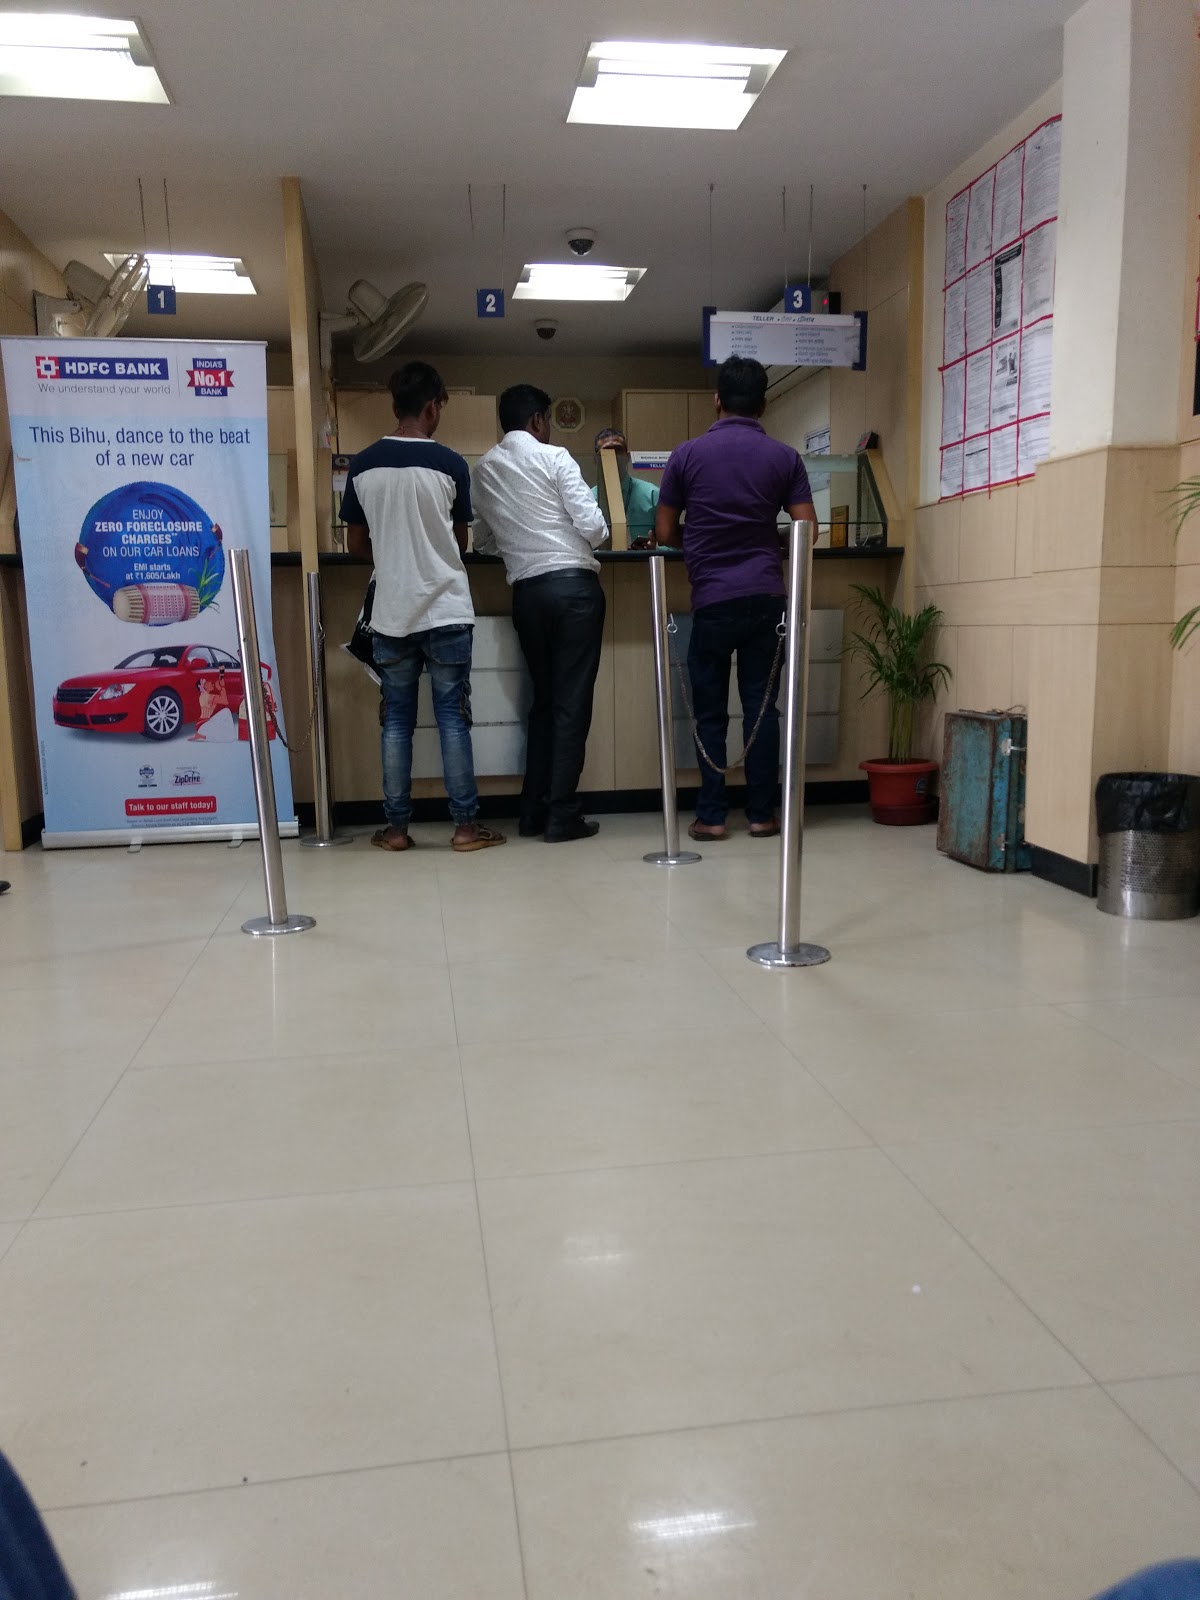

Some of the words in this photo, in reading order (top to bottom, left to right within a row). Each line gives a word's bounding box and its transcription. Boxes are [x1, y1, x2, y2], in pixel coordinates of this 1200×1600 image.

[158, 290, 165, 309] 1
[486, 294, 496, 312] 2
[793, 290, 803, 308] 3
[65, 362, 110, 375] HDFC
[115, 363, 162, 375] BANK
[196, 360, 223, 368] INDIA'S
[194, 370, 226, 386] No.1
[38, 383, 55, 393] We
[58, 384, 116, 394] understand
[119, 385, 140, 395] your
[143, 385, 171, 394] world
[200, 388, 223, 396] BANK
[29, 426, 65, 443] This
[70, 427, 111, 446] Bihu,
[116, 428, 164, 443] dance
[169, 429, 184, 443] to
[189, 428, 214, 444] the
[219, 428, 251, 444] beat
[96, 450, 111, 466] of
[116, 455, 126, 466] a
[131, 454, 164, 466] new
[169, 453, 195, 466] car
[132, 509, 163, 520] ENJOY
[95, 522, 123, 532] ZERO
[126, 522, 203, 532] FORECLOSURE
[102, 546, 117, 557] ON
[120, 546, 141, 557] OUR
[143, 547, 164, 557] CAR
[166, 547, 200, 557] LOANS
[134, 563, 148, 571] EMI
[150, 563, 171, 571] starts
[125, 572, 133, 580] at
[129, 803, 145, 811] Talk
[146, 803, 154, 811] to
[170, 802, 188, 810] staff
[190, 801, 214, 810] today!
